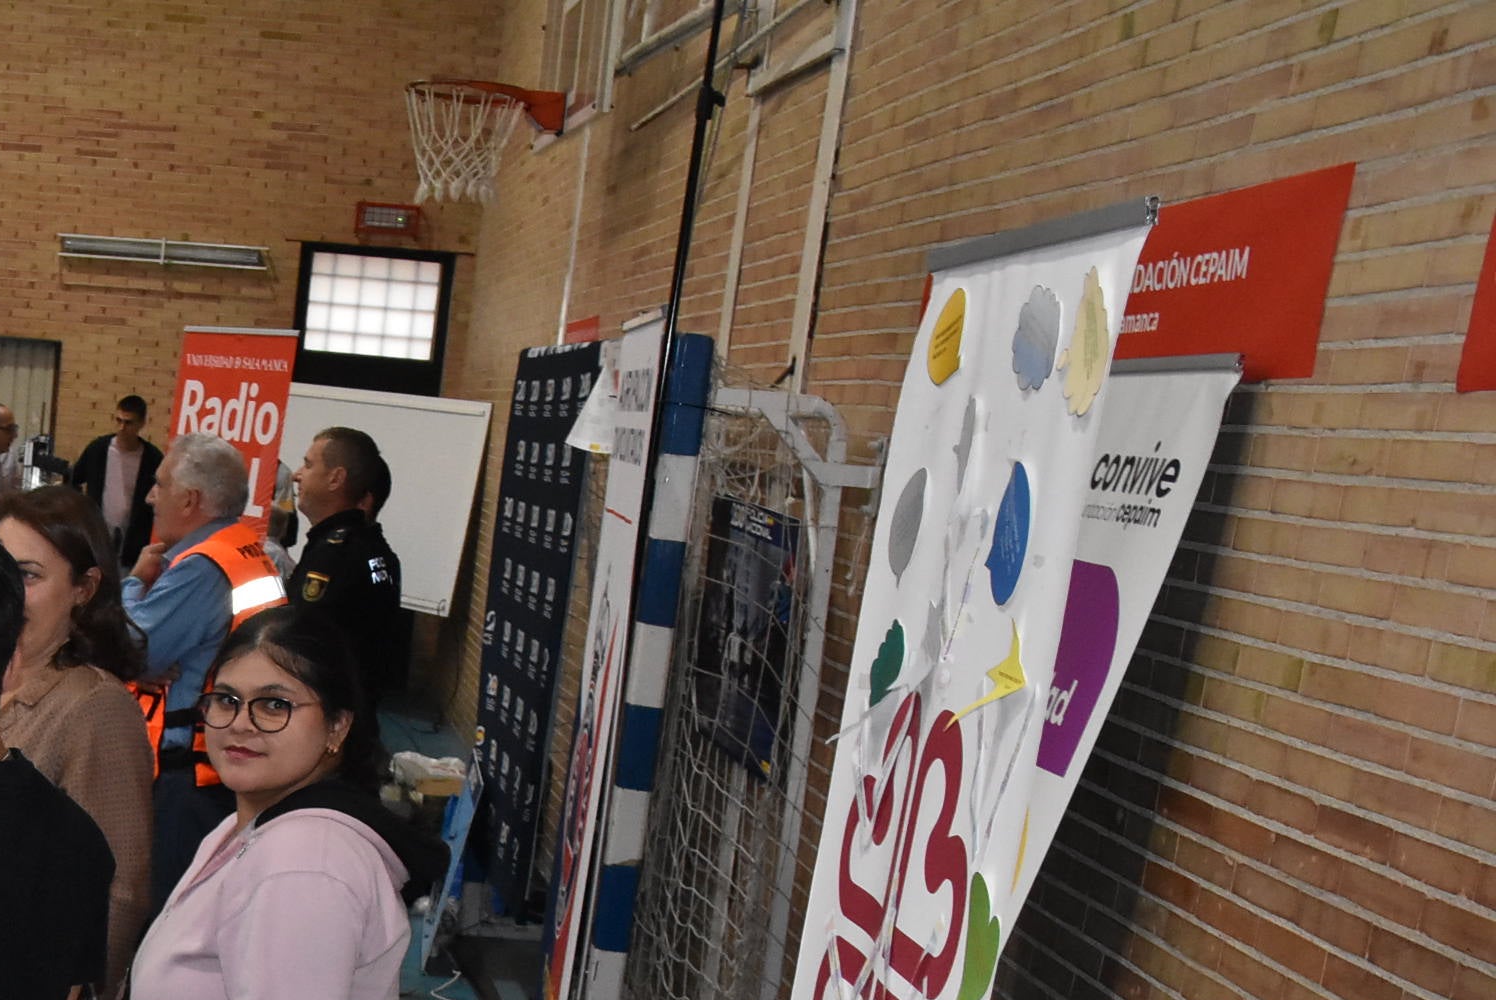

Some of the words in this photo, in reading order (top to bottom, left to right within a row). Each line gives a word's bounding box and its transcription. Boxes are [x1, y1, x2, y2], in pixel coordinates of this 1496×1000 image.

[1129, 251, 1191, 294] DACIÓN
[1189, 246, 1251, 286] CEPAIM
[177, 379, 280, 446] Radio
[1090, 440, 1181, 498] convive
